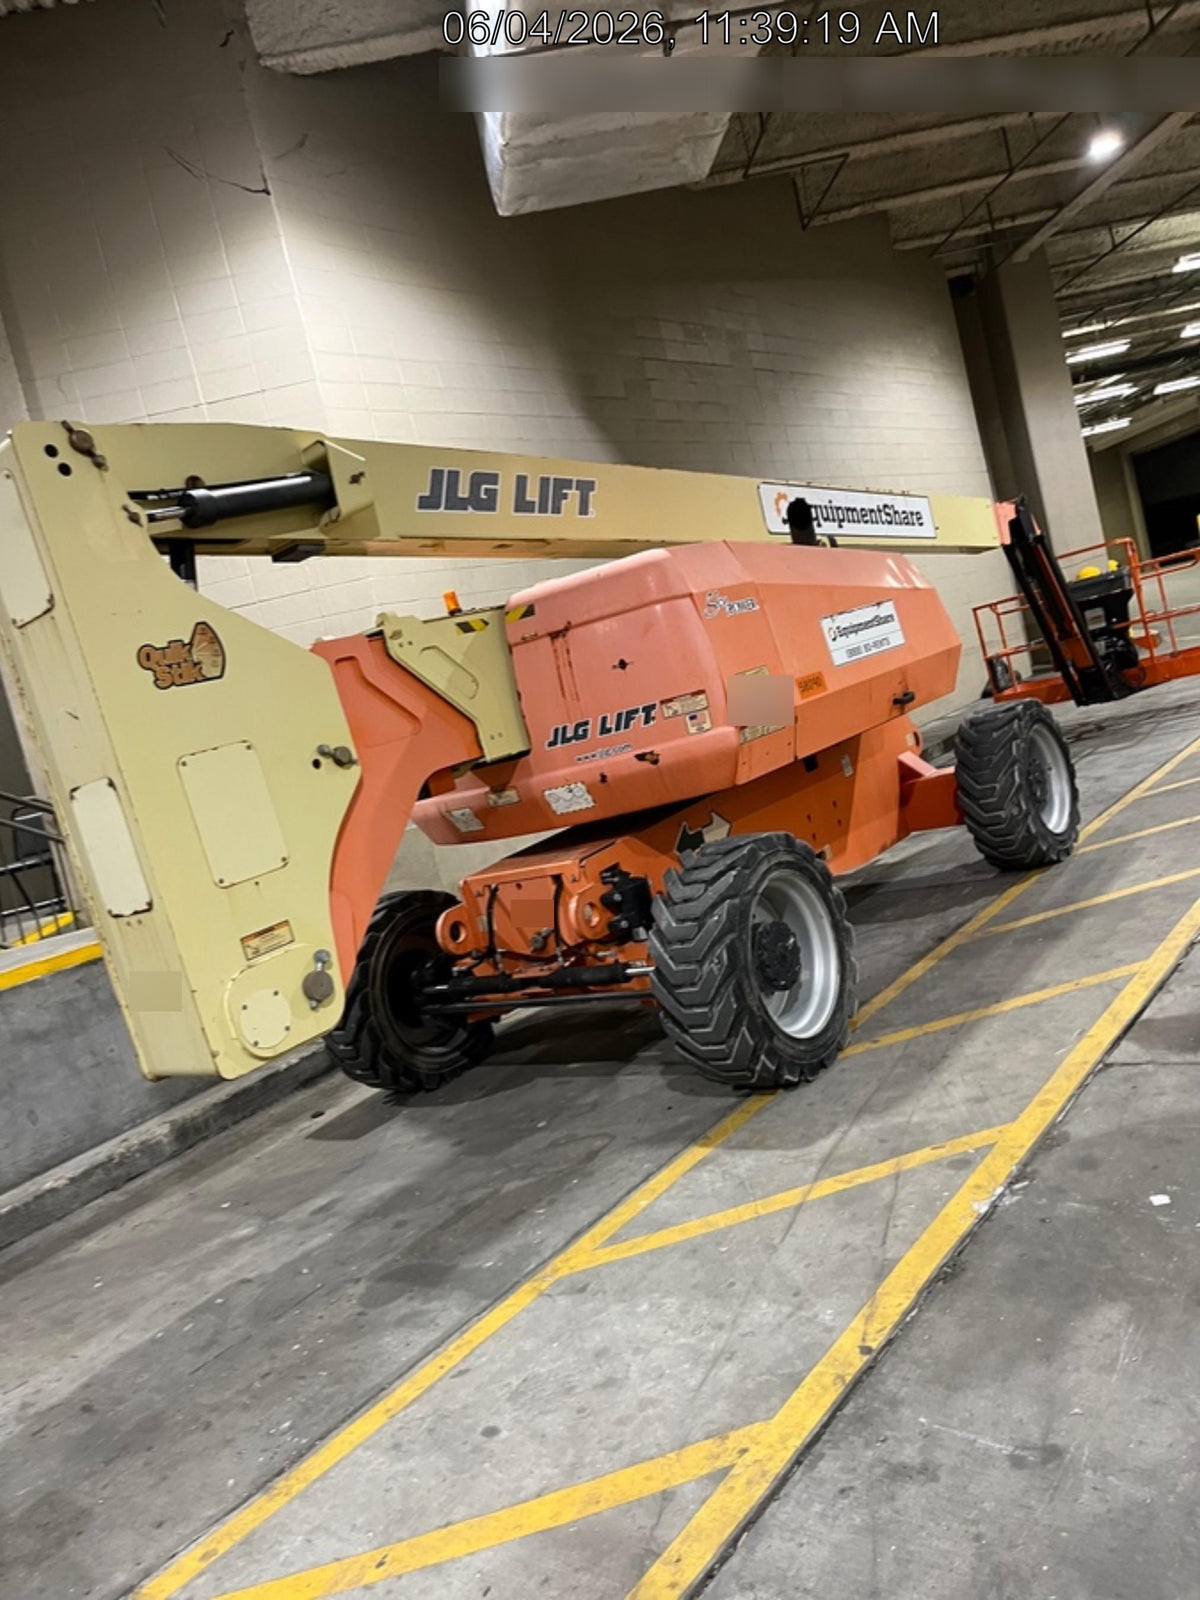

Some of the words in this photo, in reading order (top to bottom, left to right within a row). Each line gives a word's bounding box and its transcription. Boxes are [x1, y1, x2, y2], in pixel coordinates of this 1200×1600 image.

[416, 468, 500, 513] JLG
[512, 474, 596, 518] LIFT
[808, 499, 925, 528] quipmentShare
[547, 720, 591, 748] JLG
[599, 703, 657, 736] LIFT
